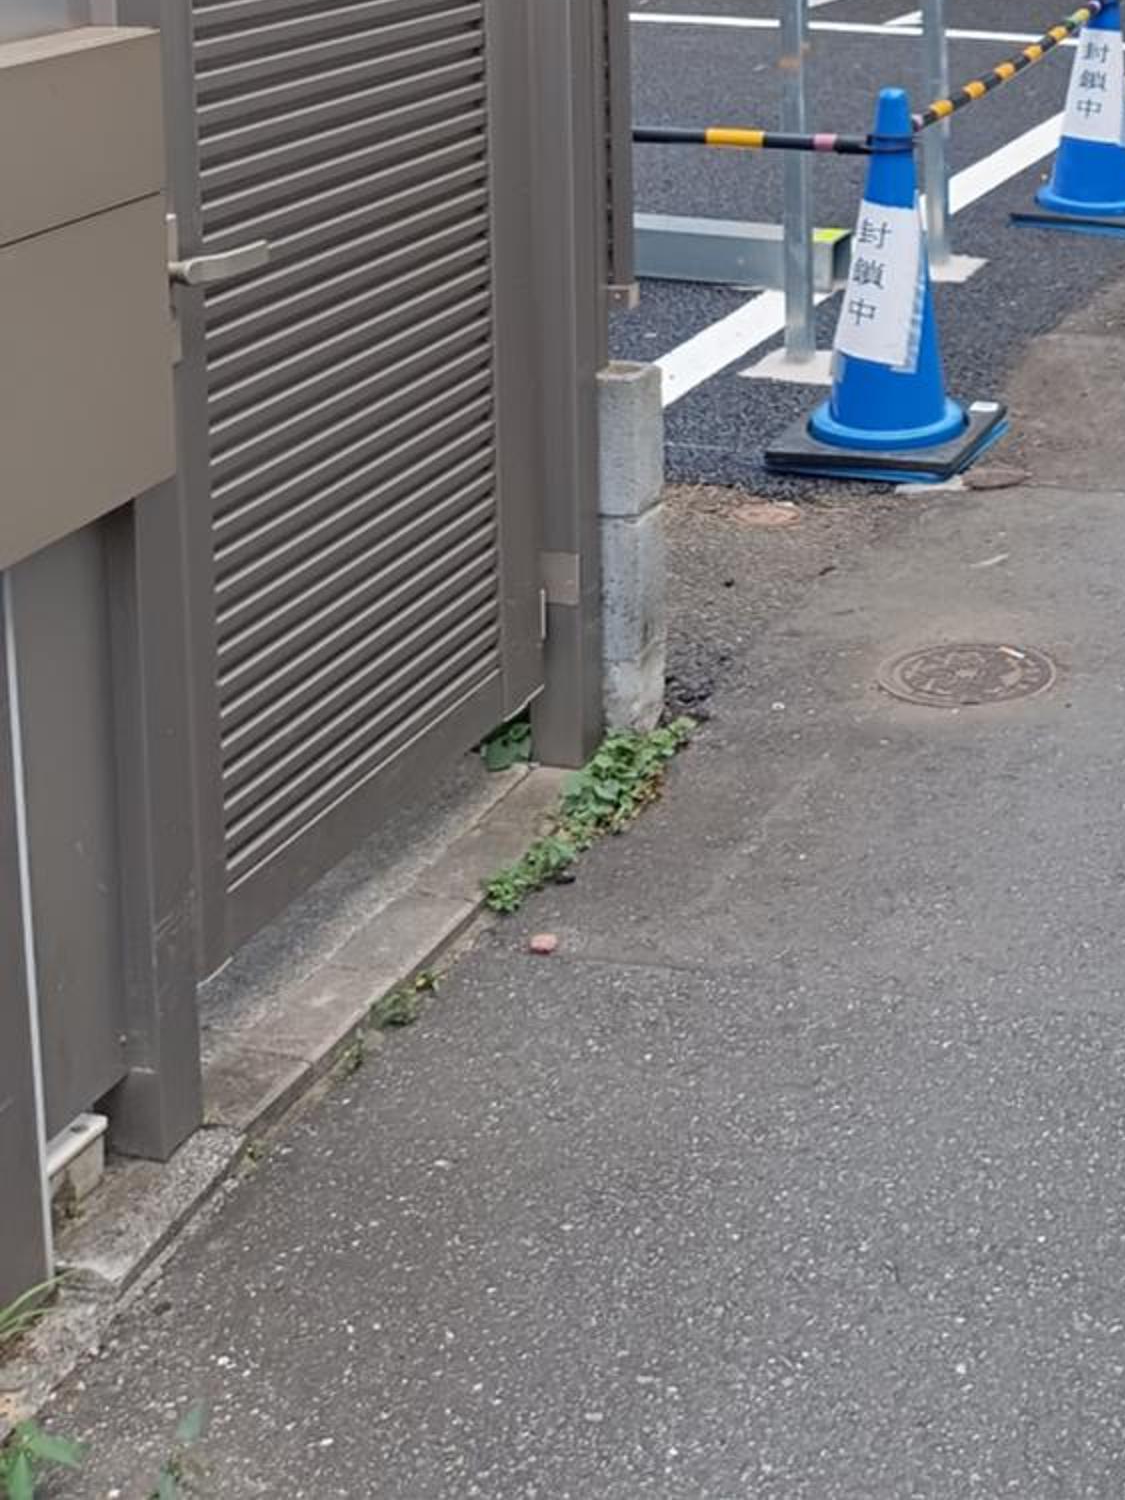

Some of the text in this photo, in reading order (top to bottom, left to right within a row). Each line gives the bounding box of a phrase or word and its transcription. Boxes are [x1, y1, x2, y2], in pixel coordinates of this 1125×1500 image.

[1076, 41, 1110, 119] 封鎖中
[848, 218, 892, 327] 封鎖中
